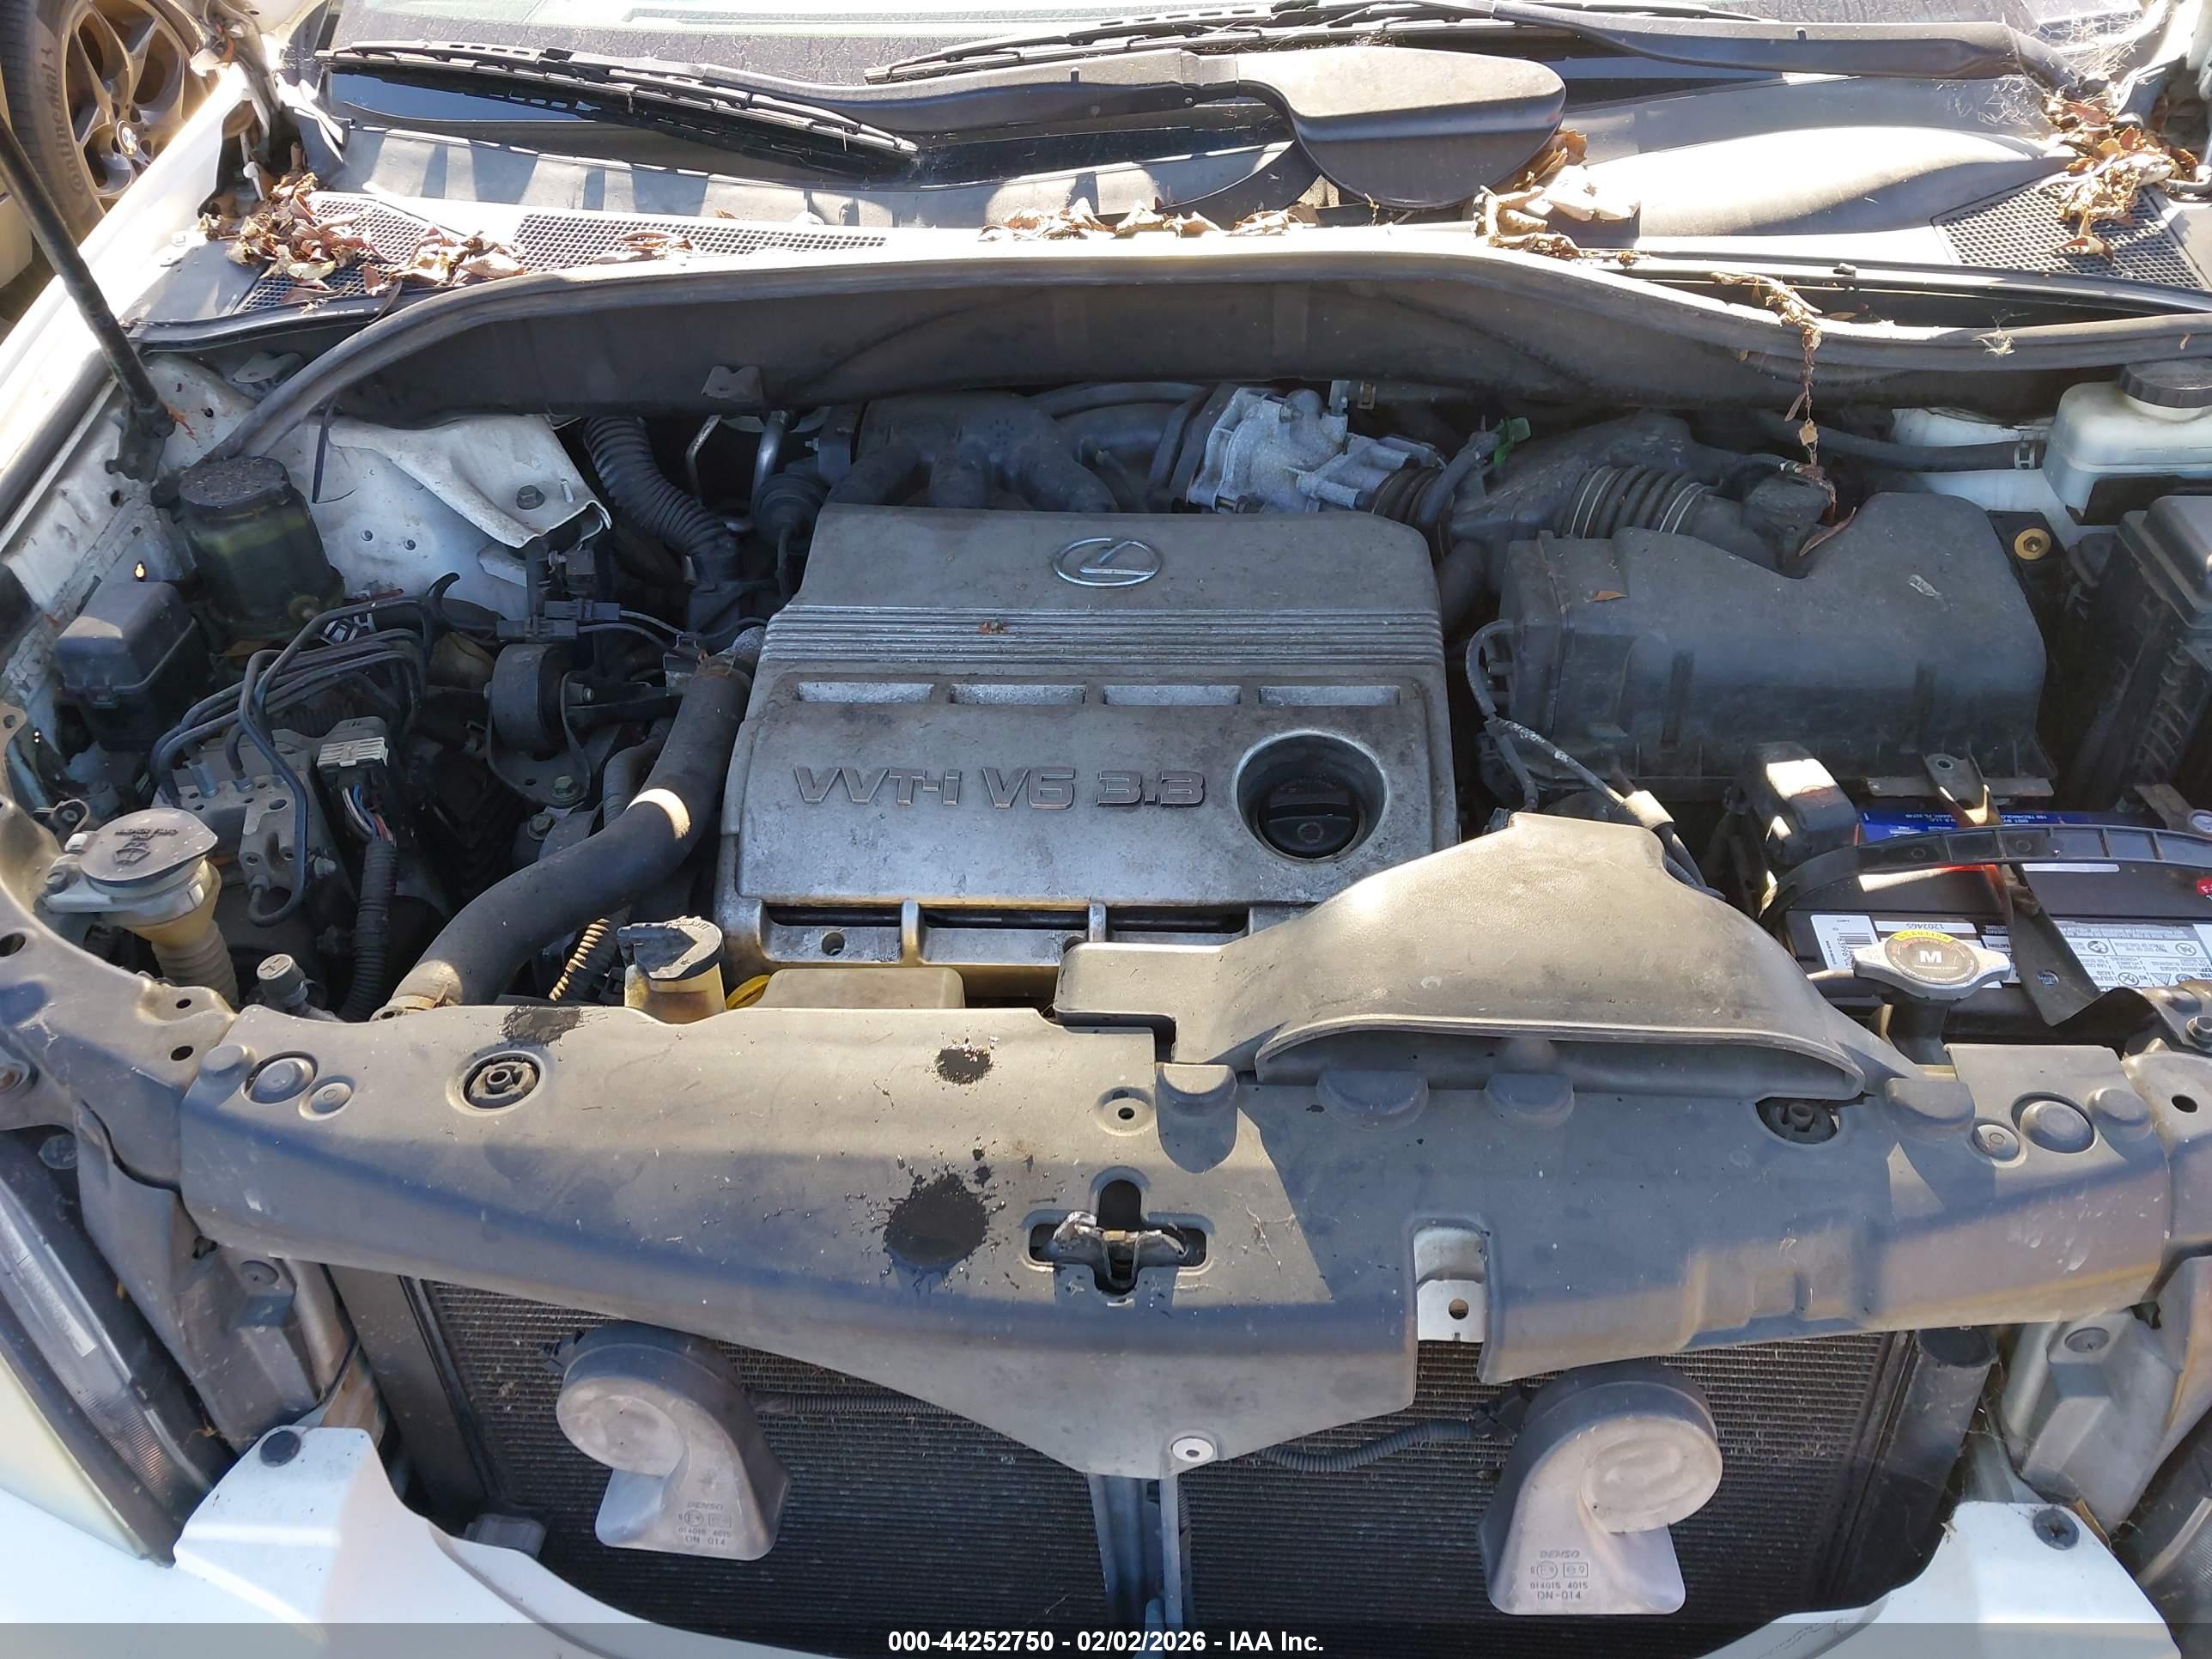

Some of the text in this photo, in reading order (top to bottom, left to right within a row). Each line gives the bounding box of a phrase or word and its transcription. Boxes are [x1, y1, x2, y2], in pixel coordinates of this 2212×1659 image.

[982, 768, 1076, 811] V6
[1097, 769, 1205, 809] 3.3
[1919, 951, 1942, 963] M
[1540, 1550, 1581, 1559] DENSO
